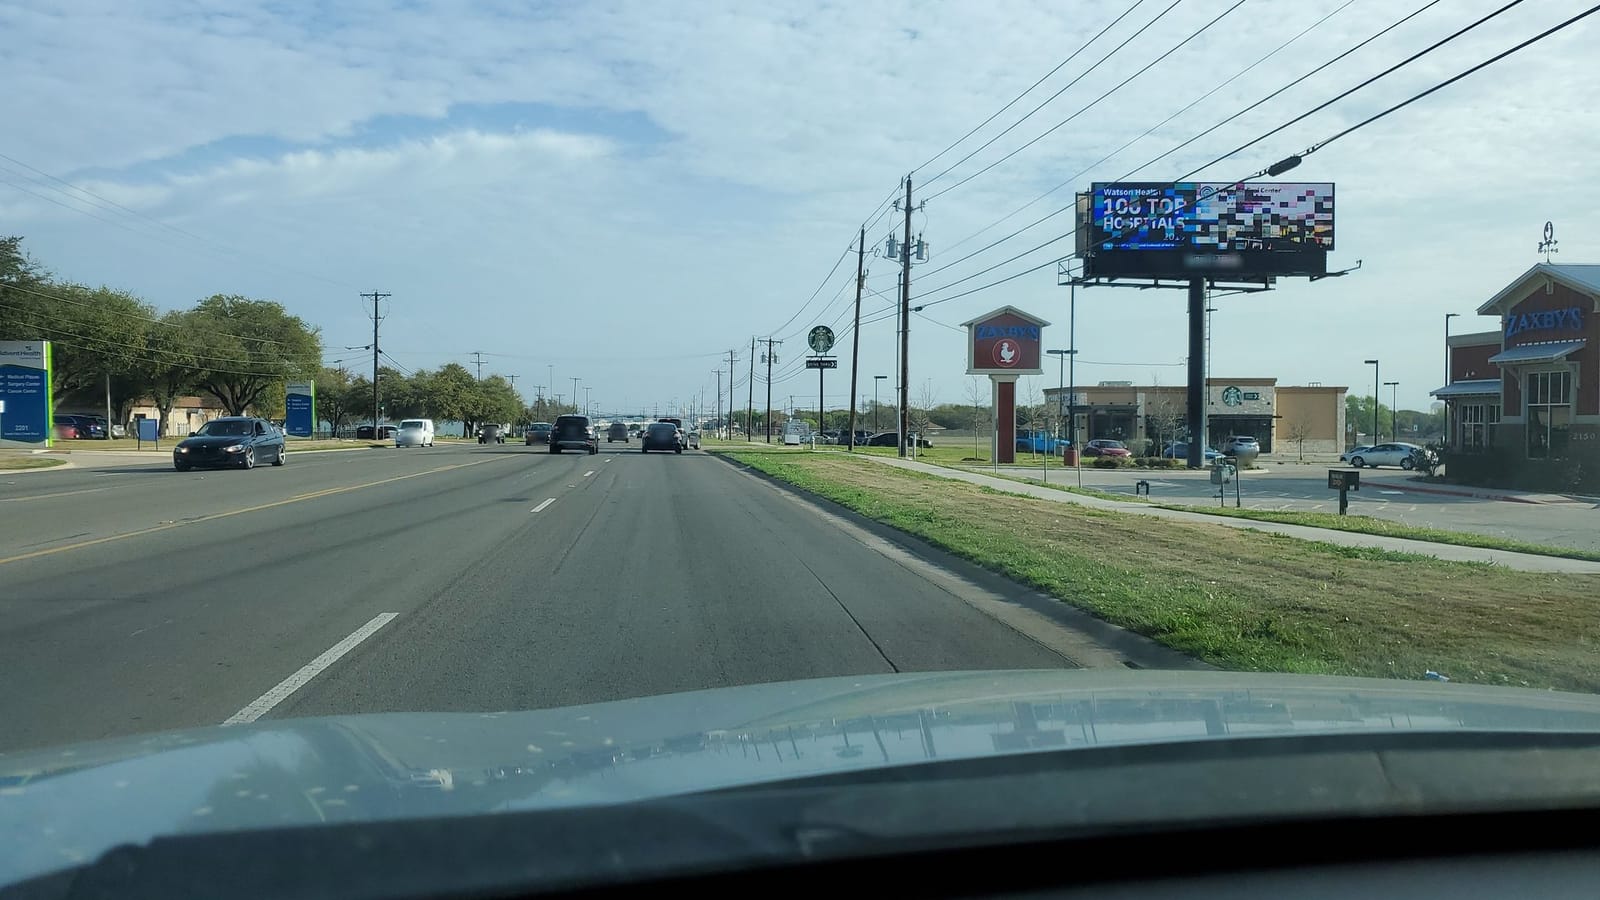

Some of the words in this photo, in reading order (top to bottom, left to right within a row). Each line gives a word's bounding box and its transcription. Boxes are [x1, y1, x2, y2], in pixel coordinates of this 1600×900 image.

[1103, 188, 1133, 196] Watson
[1103, 198, 1141, 215] 100
[1146, 198, 1187, 215] TOP
[1103, 217, 1185, 230] HOSPITALS
[1506, 307, 1582, 338] ZAXBY'S
[976, 325, 1039, 340] ZAXBY'S
